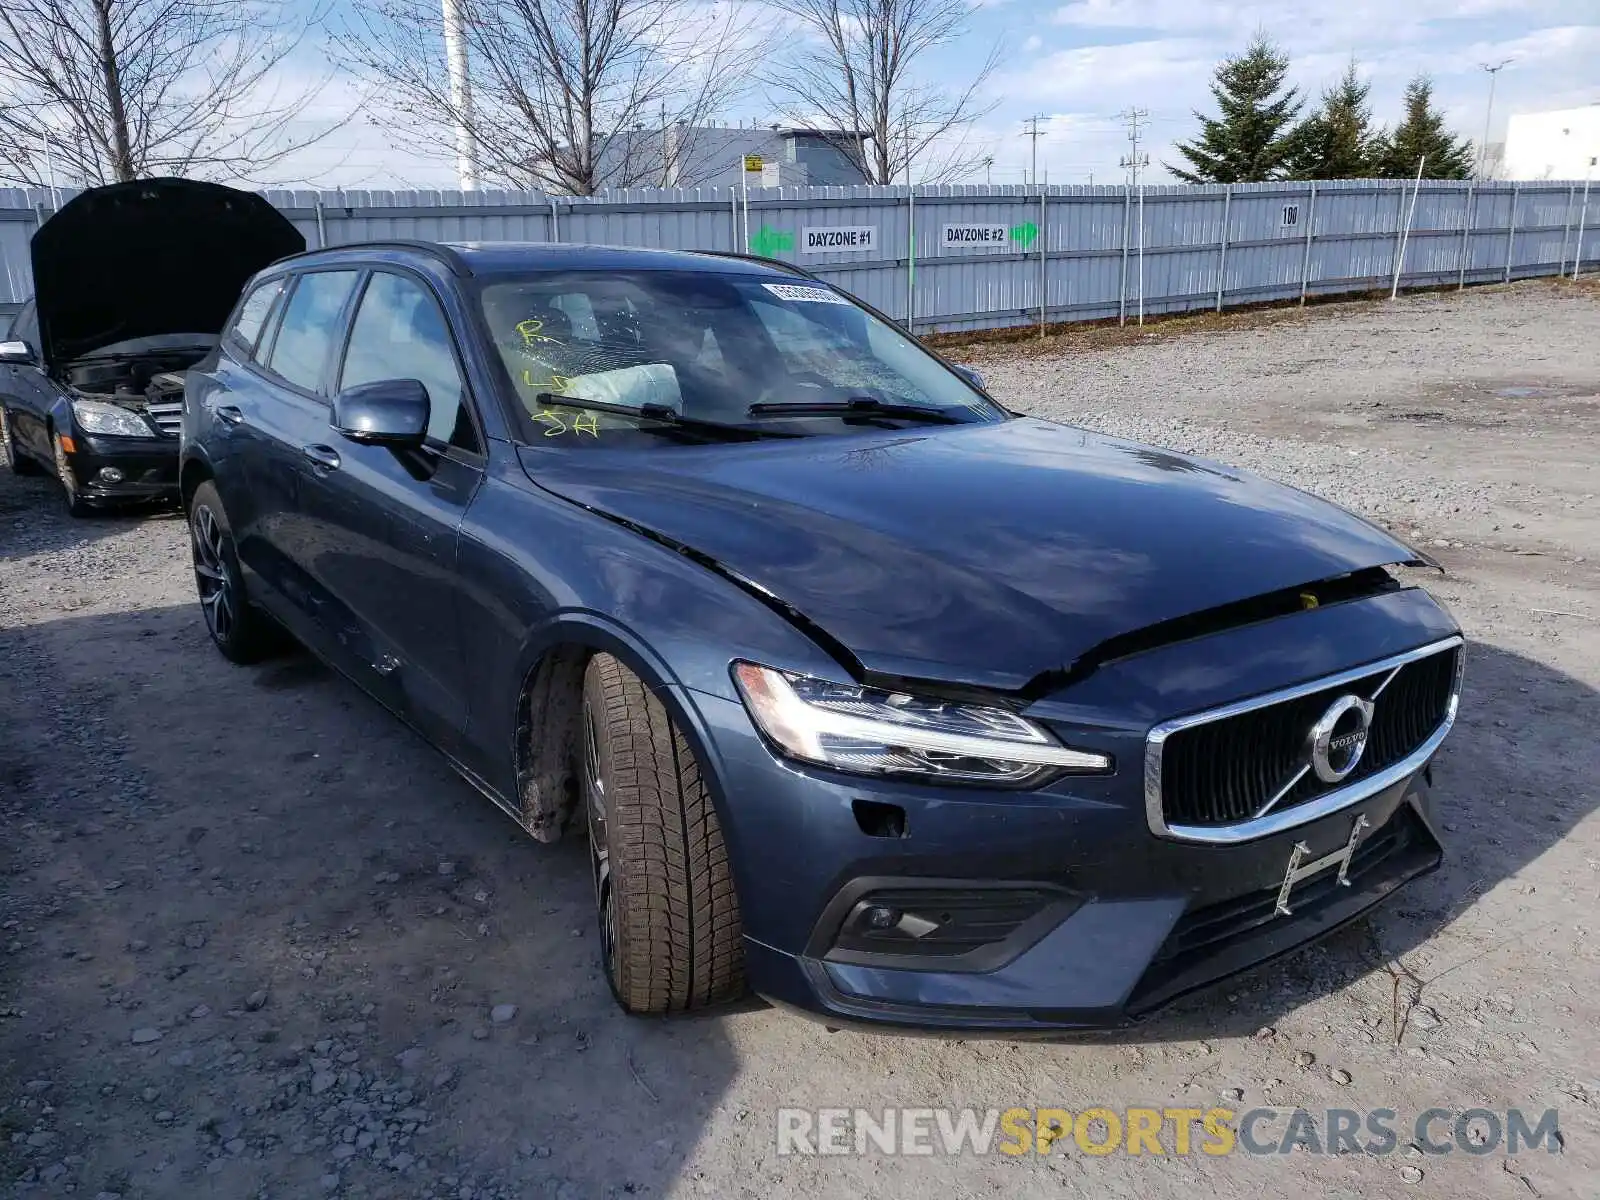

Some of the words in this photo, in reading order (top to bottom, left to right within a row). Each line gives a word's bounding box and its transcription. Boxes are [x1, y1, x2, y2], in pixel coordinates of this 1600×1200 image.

[808, 232, 857, 247] DAYZONE
[859, 230, 872, 245] #1
[947, 228, 990, 242] DAYZONE
[991, 228, 1004, 241] #2
[1330, 731, 1365, 750] VOLVO
